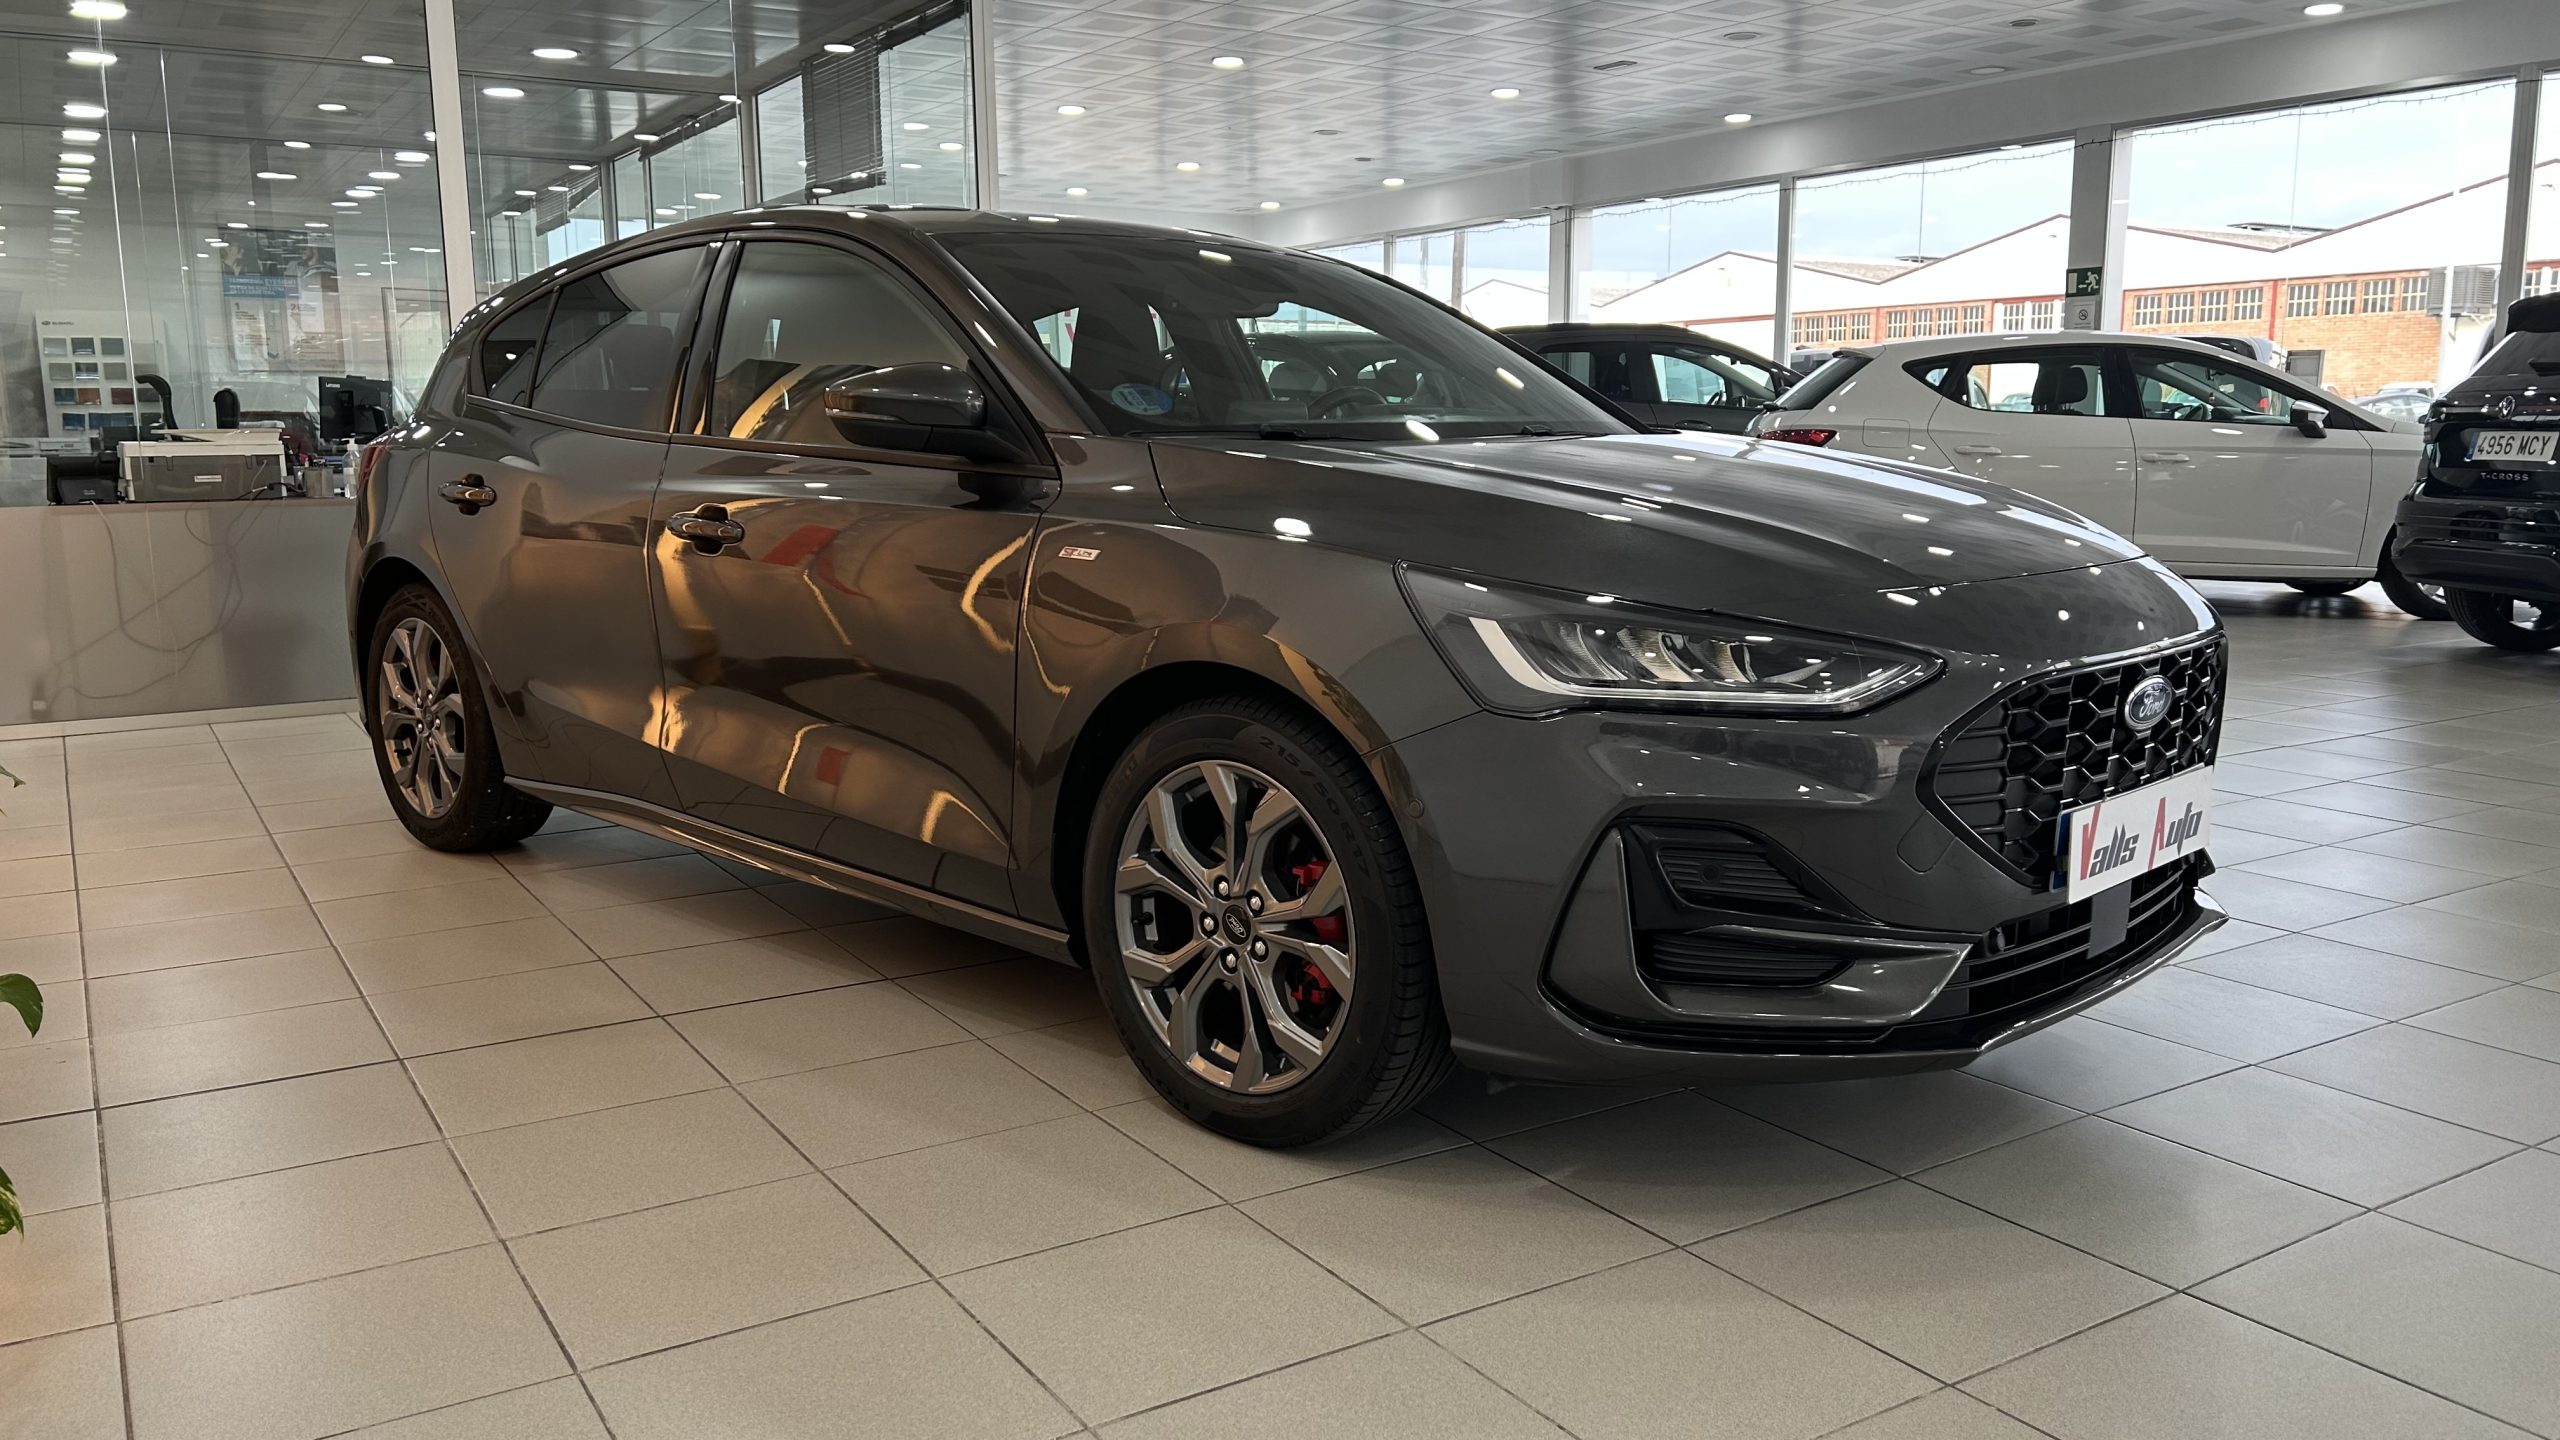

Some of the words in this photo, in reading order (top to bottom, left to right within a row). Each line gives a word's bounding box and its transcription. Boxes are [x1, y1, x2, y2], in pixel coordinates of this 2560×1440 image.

[2477, 435, 2515, 456] 4956
[2516, 435, 2553, 456] MCY
[2480, 472, 2529, 481] T-CROSS
[2139, 689, 2166, 718] Ford
[2080, 803, 2140, 881] Valls
[2147, 796, 2203, 871] Auto
